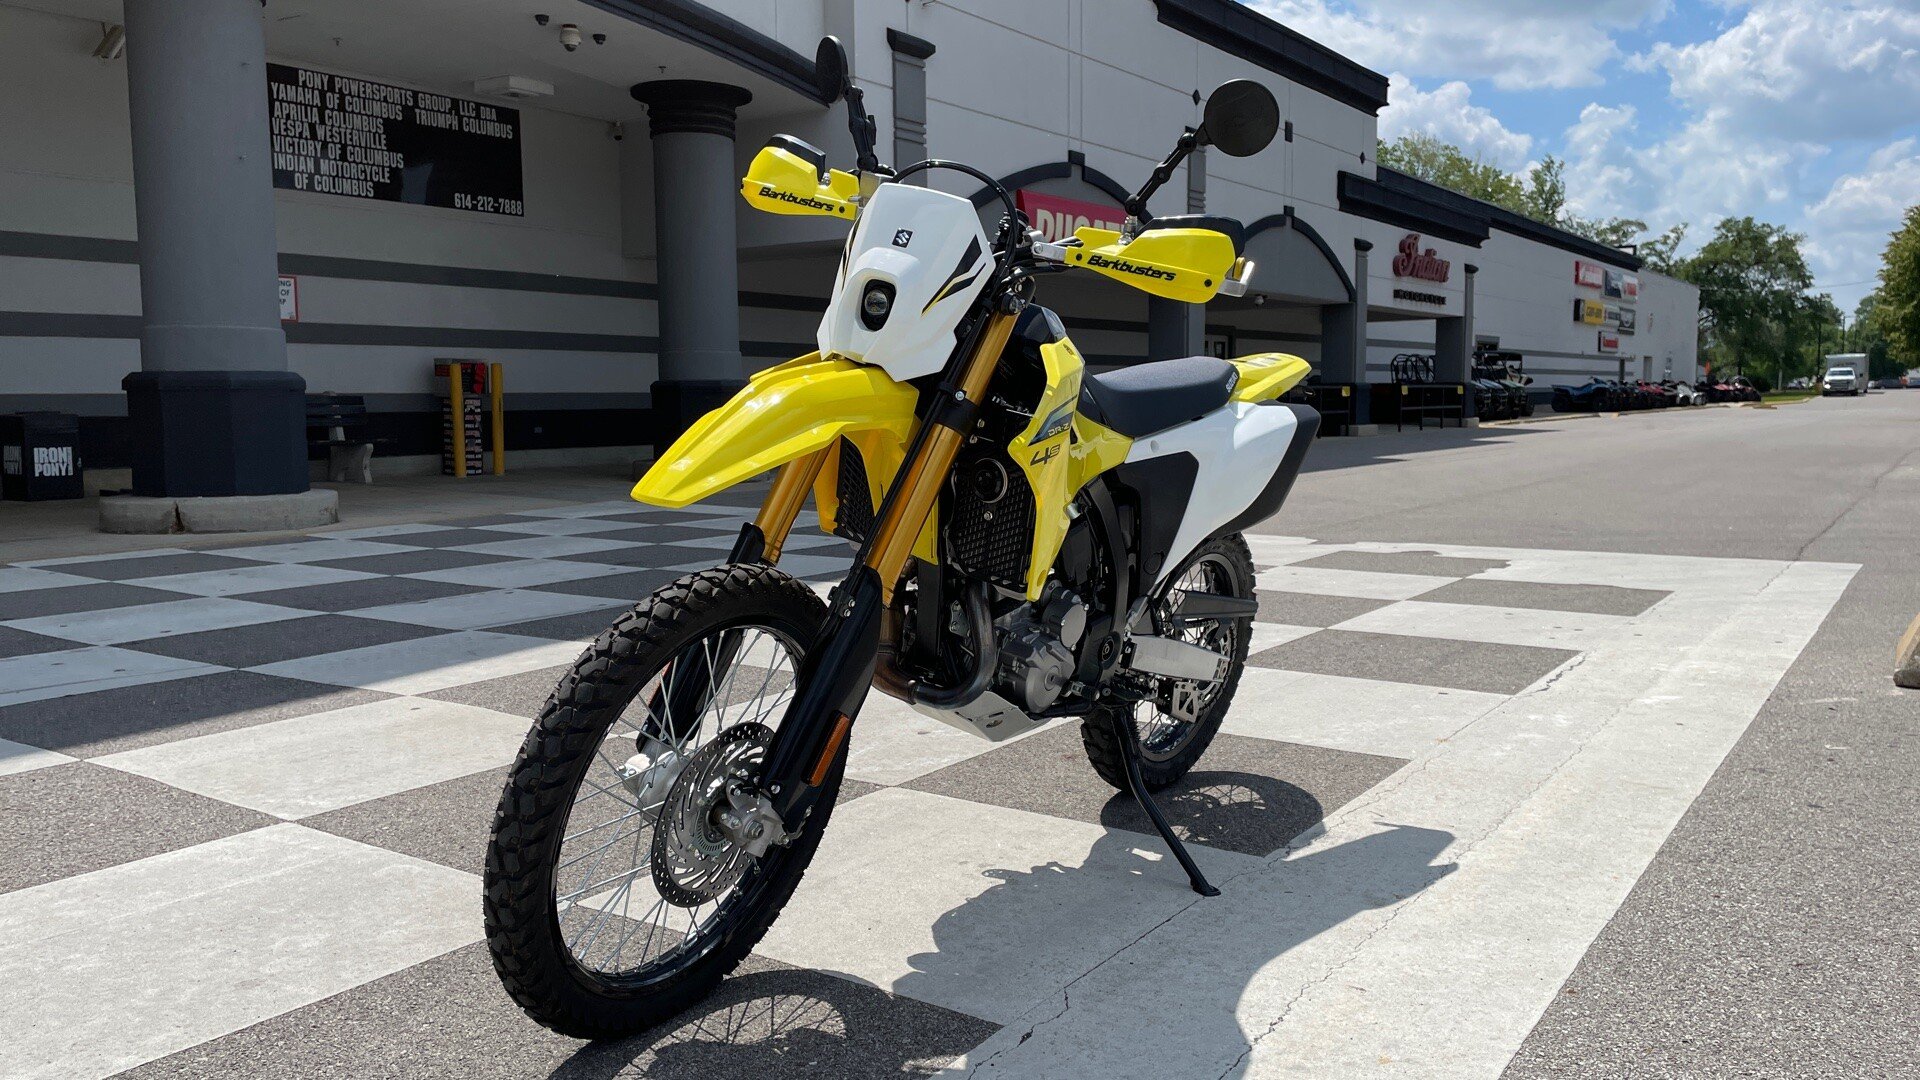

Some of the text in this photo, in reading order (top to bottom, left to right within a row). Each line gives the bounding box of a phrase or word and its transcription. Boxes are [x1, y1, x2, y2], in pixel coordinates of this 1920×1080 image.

[271, 82, 402, 121] YAMAHA OF COLUMBUS
[298, 69, 329, 90] PONY
[334, 76, 414, 106] POWERSPORTS
[459, 100, 476, 117] LLC
[480, 106, 497, 121] DBA
[273, 101, 384, 134] APRILIA COLUMBUS
[414, 108, 513, 139] TRIUMPH COLUMBUS
[272, 117, 387, 150] VESPA WESTERVILLE
[272, 135, 404, 169] VICTORY OF COLUMBUS
[274, 153, 390, 183] INDIAN MOTORCYCLE
[294, 172, 374, 197] OF COLUMBUS
[758, 186, 835, 212] Barkbusters
[454, 192, 523, 215] 614-212-7888
[1087, 255, 1176, 281] Barkbusters
[1393, 233, 1450, 283] Indian
[1047, 422, 1070, 437] DR-Z
[33, 447, 68, 464] IRON
